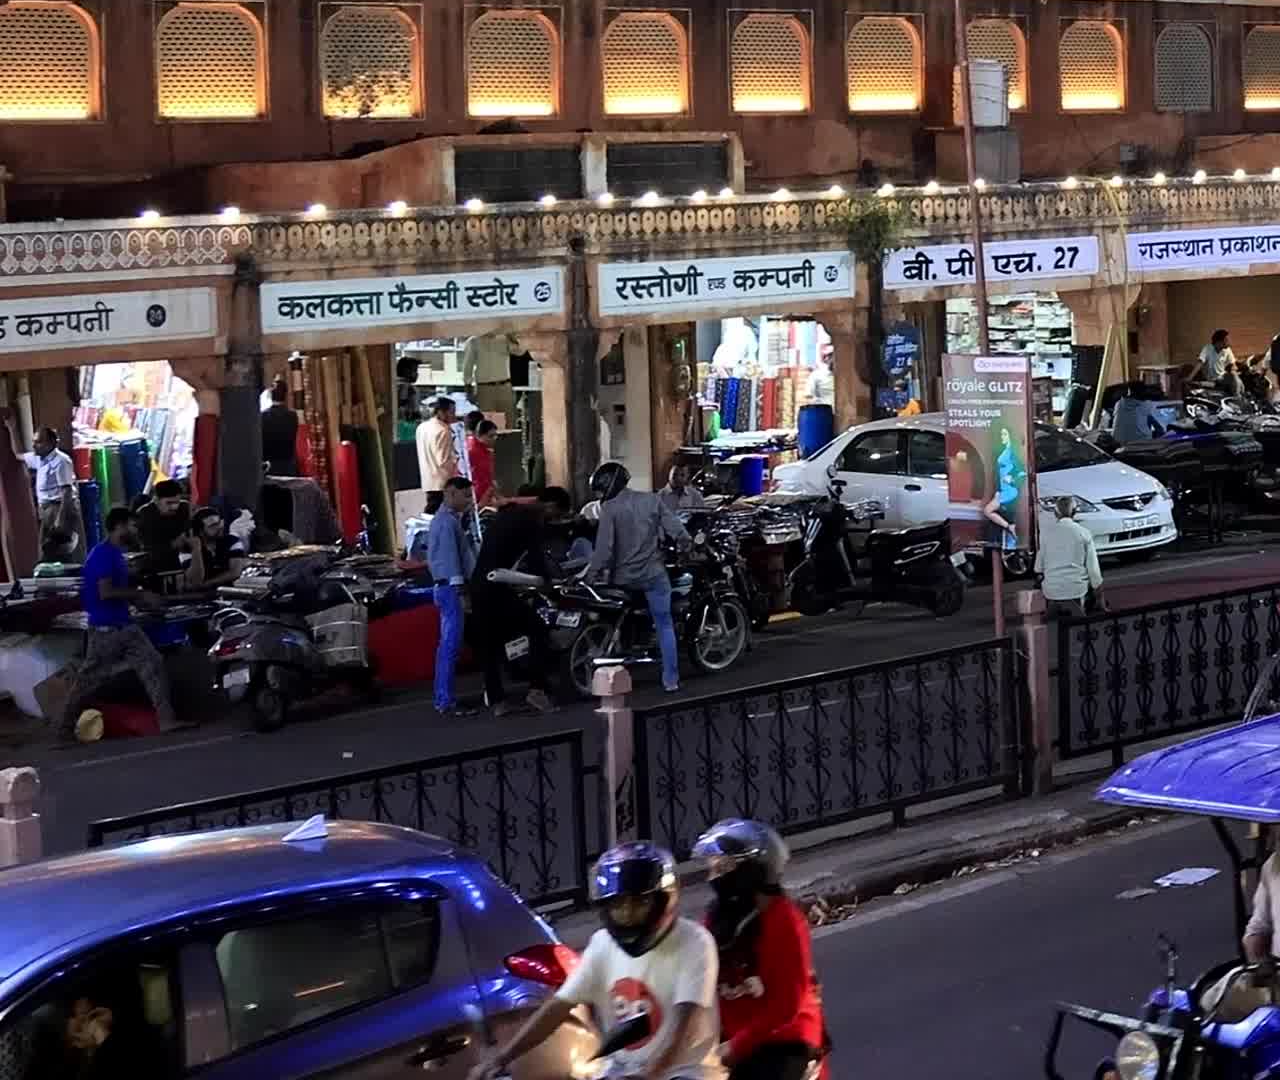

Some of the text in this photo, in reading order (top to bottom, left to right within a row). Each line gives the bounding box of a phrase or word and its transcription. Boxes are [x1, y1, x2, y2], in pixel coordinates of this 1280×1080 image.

[1138, 238, 1214, 260] राजस्थान
[903, 251, 938, 281] बी.
[992, 252, 1042, 275] एच.
[1053, 246, 1079, 270] 27
[615, 265, 703, 301] रस्तोगी
[732, 259, 815, 292] कम्पनी
[278, 292, 384, 320] कलकत्ता
[388, 281, 460, 313] फैन्सी
[464, 278, 520, 307] स्टोर
[14, 301, 114, 337] कम्पनी
[988, 381, 1023, 393] GLITZ
[948, 409, 977, 418] STEALS
[949, 419, 992, 428] SPOTLIGHT
